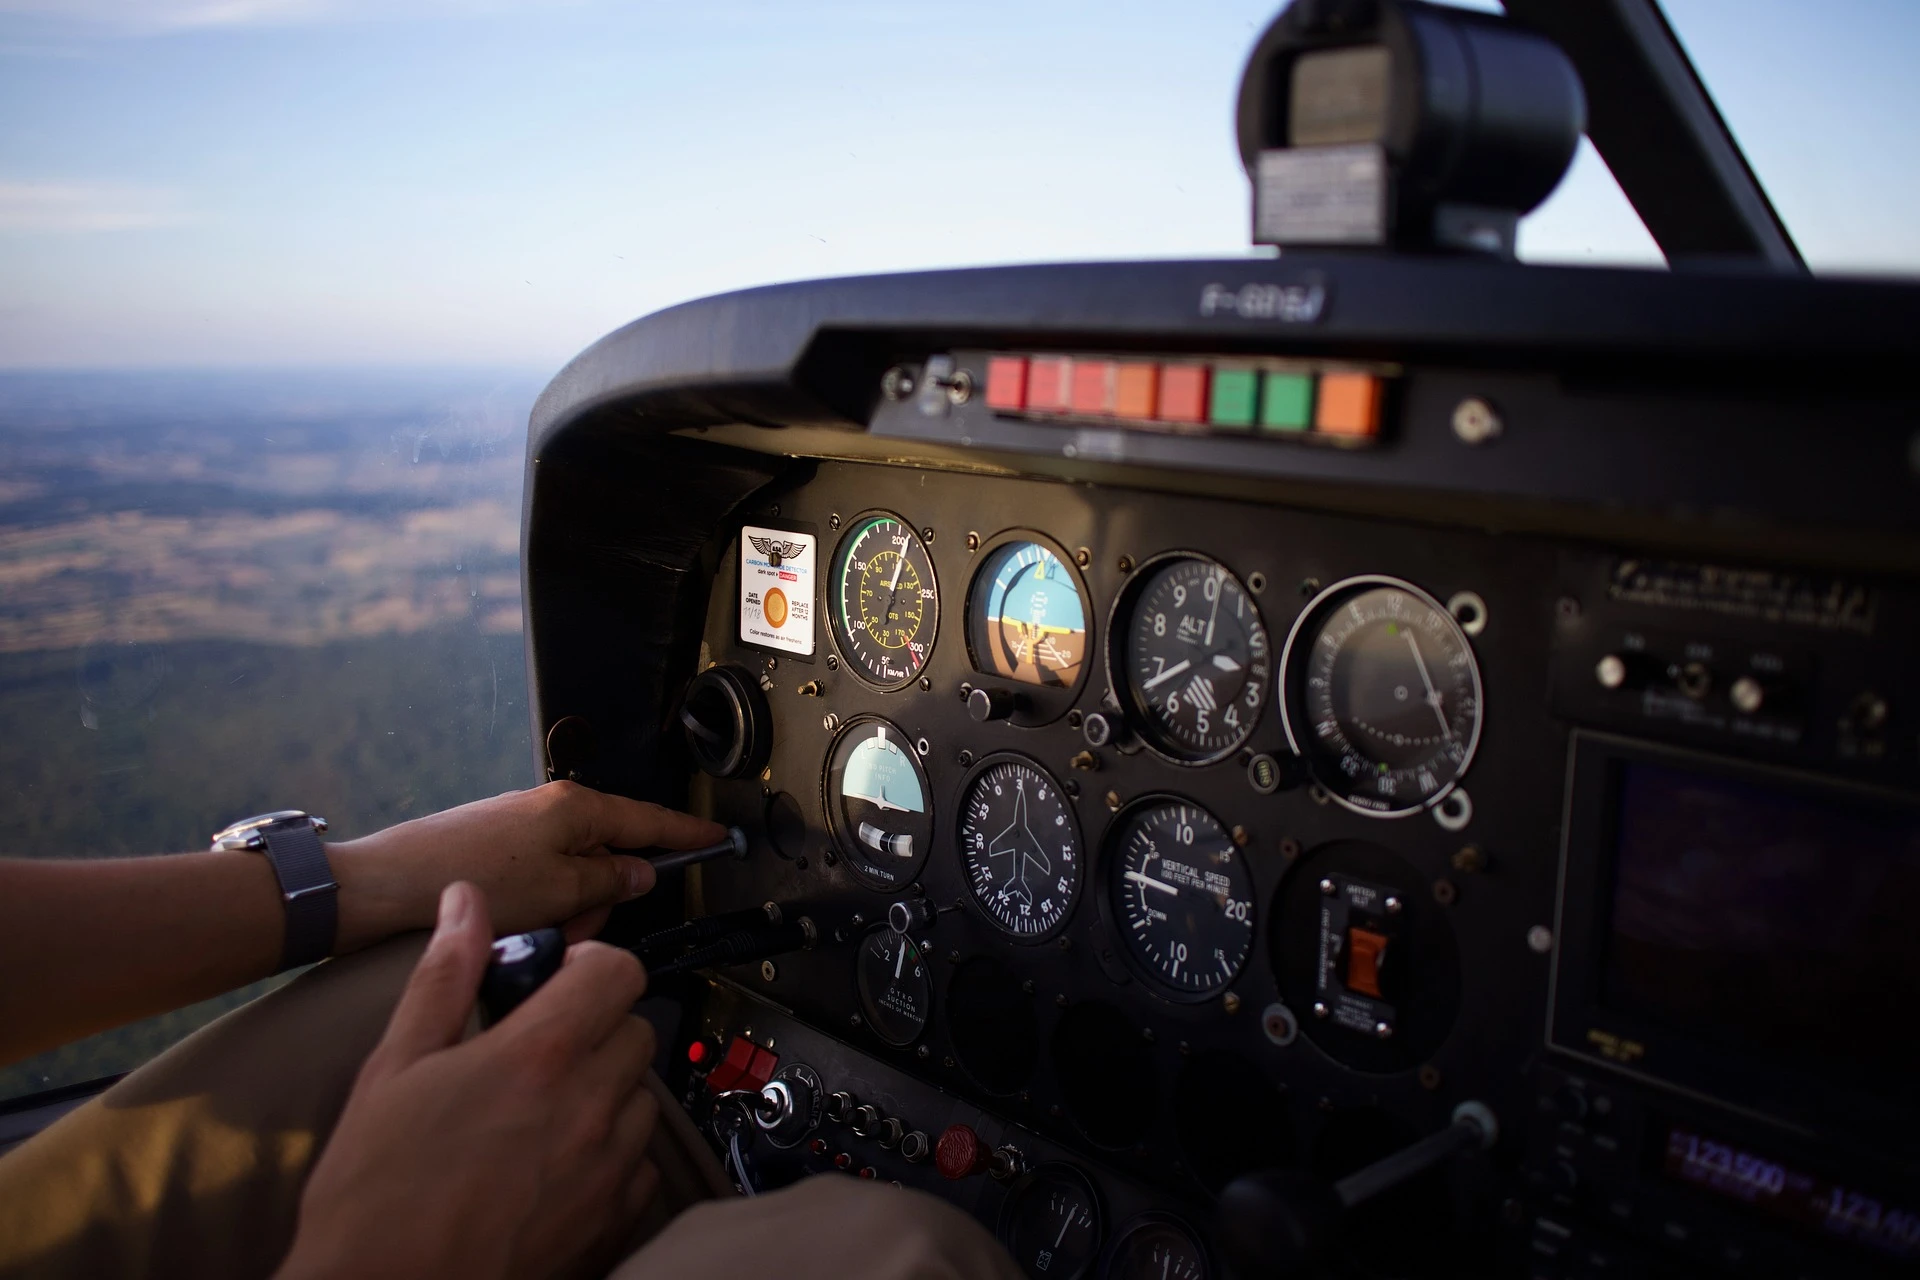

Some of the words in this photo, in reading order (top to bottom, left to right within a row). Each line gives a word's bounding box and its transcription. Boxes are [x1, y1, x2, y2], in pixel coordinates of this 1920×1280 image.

[892, 536, 905, 546] 200
[746, 559, 763, 567] CARBON
[786, 566, 807, 574] DETECTOR
[854, 561, 867, 571] 150
[779, 572, 797, 580] DANGER
[866, 589, 873, 597] 70
[1203, 576, 1218, 602] 0
[745, 597, 761, 606] OPENED
[1173, 584, 1187, 609] 9
[792, 600, 809, 609] REPLACE
[1237, 594, 1244, 619] 1
[791, 613, 808, 621] MONTHS
[871, 616, 879, 624] 50
[904, 610, 915, 618] 150
[853, 620, 866, 630] 100
[1153, 612, 1167, 637] 8
[1179, 613, 1206, 636] ALT
[749, 628, 760, 636] Color
[760, 631, 775, 640] restores
[882, 629, 890, 638] 30
[894, 628, 905, 637] 170
[1248, 622, 1264, 648] 2
[910, 641, 924, 653] 300
[1152, 656, 1166, 678] 7
[1245, 681, 1260, 708] 3
[1166, 690, 1180, 714] 6
[1196, 710, 1210, 733] 5
[1223, 703, 1240, 728] 4
[861, 749, 867, 759] L
[900, 756, 906, 767] R
[869, 763, 877, 771] NO
[878, 764, 897, 775] PITCH
[874, 772, 891, 782] INFO
[995, 785, 1003, 796] 0
[1016, 779, 1022, 790] 3
[1038, 789, 1046, 800] 6
[979, 803, 990, 820] 33
[1055, 815, 1064, 826] 9
[1175, 823, 1194, 845] 10
[975, 832, 985, 850] 30
[1149, 840, 1156, 851] 5
[1062, 844, 1072, 861] 12
[1219, 850, 1231, 863] 15
[880, 870, 895, 882] TURN
[981, 865, 993, 881] 27
[1161, 858, 1200, 879] VERTICAL
[1204, 871, 1231, 888] SPEED
[1057, 876, 1069, 894] 15
[1173, 872, 1191, 885] FEET
[1191, 877, 1206, 889] PER
[1206, 883, 1230, 896] MINUTE
[997, 890, 1011, 906] 24
[1019, 904, 1031, 916] 21
[1040, 898, 1054, 913] 18
[1225, 899, 1246, 922] 20
[1148, 908, 1167, 921] DOWN
[1145, 916, 1152, 927] 5
[884, 949, 890, 961] 2
[1170, 940, 1187, 962] 10
[1214, 947, 1225, 961] 15
[914, 966, 921, 978] 6
[887, 994, 916, 1013] SUCTION
[879, 998, 894, 1010] INCHES
[903, 1010, 924, 1024] MERCURY
